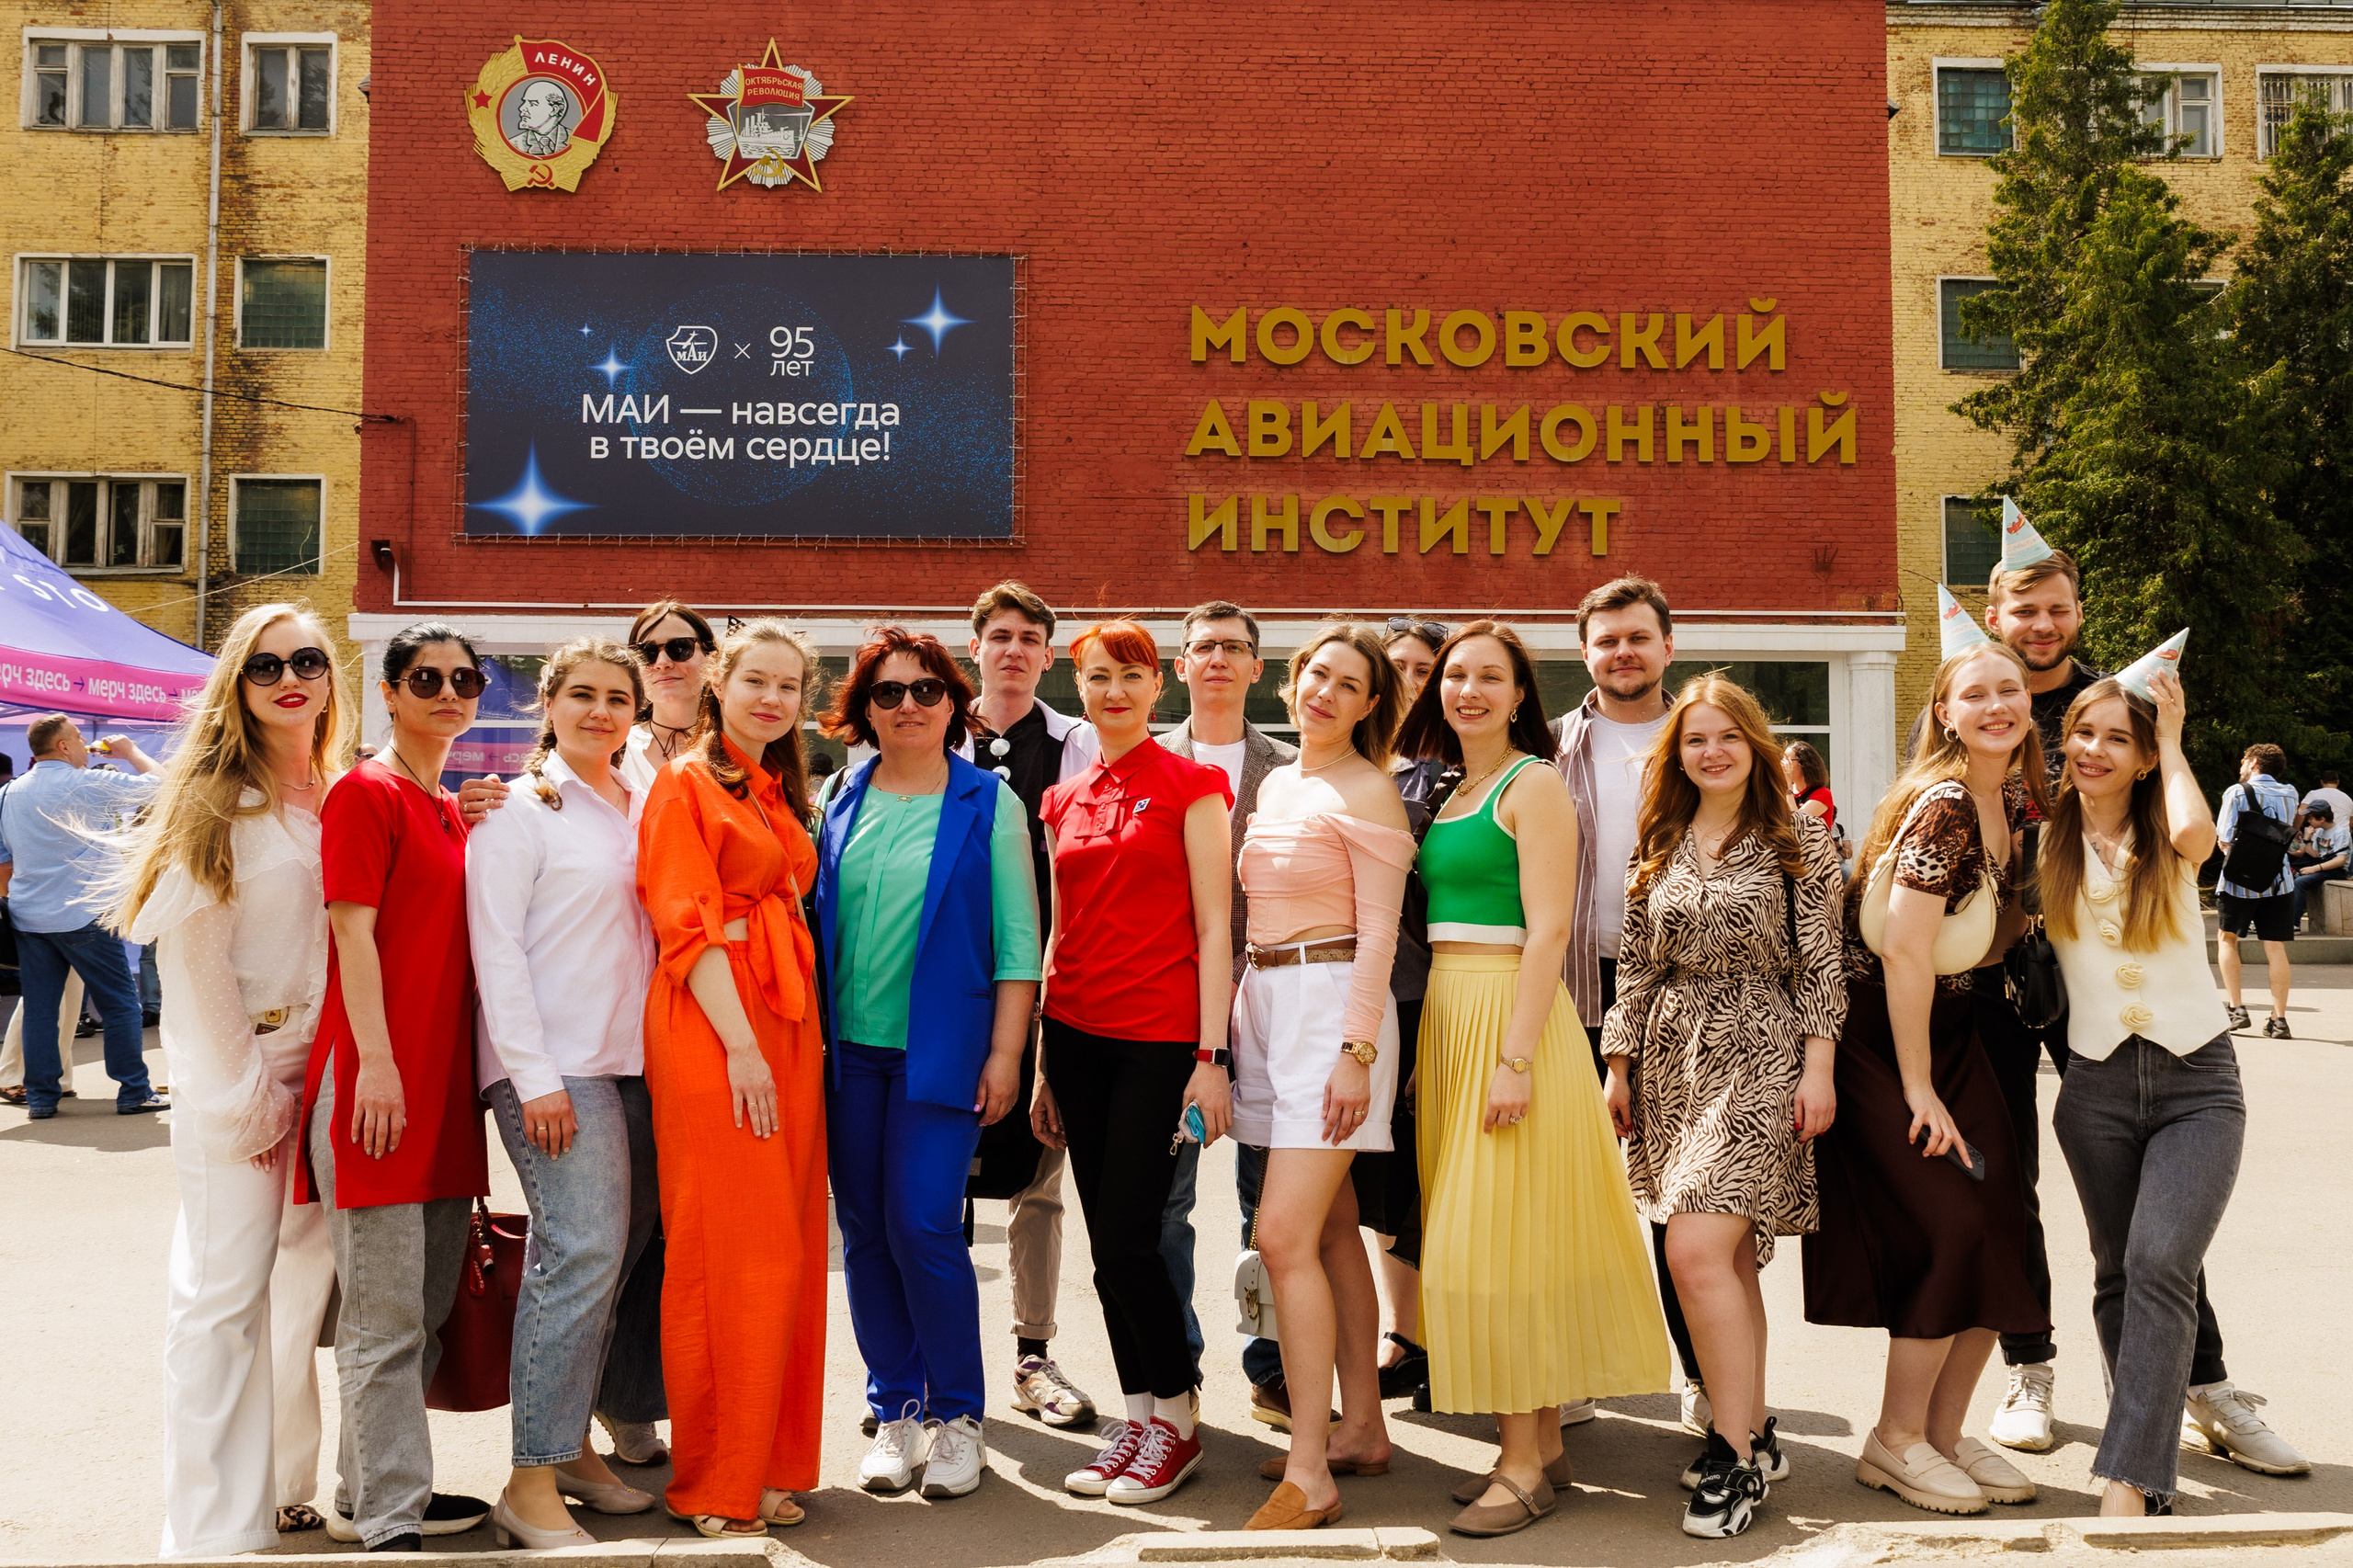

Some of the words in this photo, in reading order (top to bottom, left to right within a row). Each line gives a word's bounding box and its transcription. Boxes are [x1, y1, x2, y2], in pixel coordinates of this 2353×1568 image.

[534, 51, 597, 86] ЛЕНИН
[745, 76, 803, 91] ОКТЯБРЬСКАЯ
[747, 87, 800, 101] РЕВОЛЮЦИЯ
[769, 326, 814, 358] 95
[1190, 298, 1786, 370] МОСКОВСКИЙ
[769, 360, 814, 377] лет
[582, 394, 669, 424] МАИ
[733, 402, 900, 430] навсегда
[1185, 392, 1857, 466] АВИАЦИОННЫЙ
[590, 437, 609, 459] в
[620, 428, 733, 459] твоём
[746, 431, 890, 469] сердце!
[1188, 494, 1620, 556] ИНСТИТУТ
[26, 667, 71, 692] здесь
[88, 677, 125, 703] мерч
[129, 683, 166, 705] здесь
